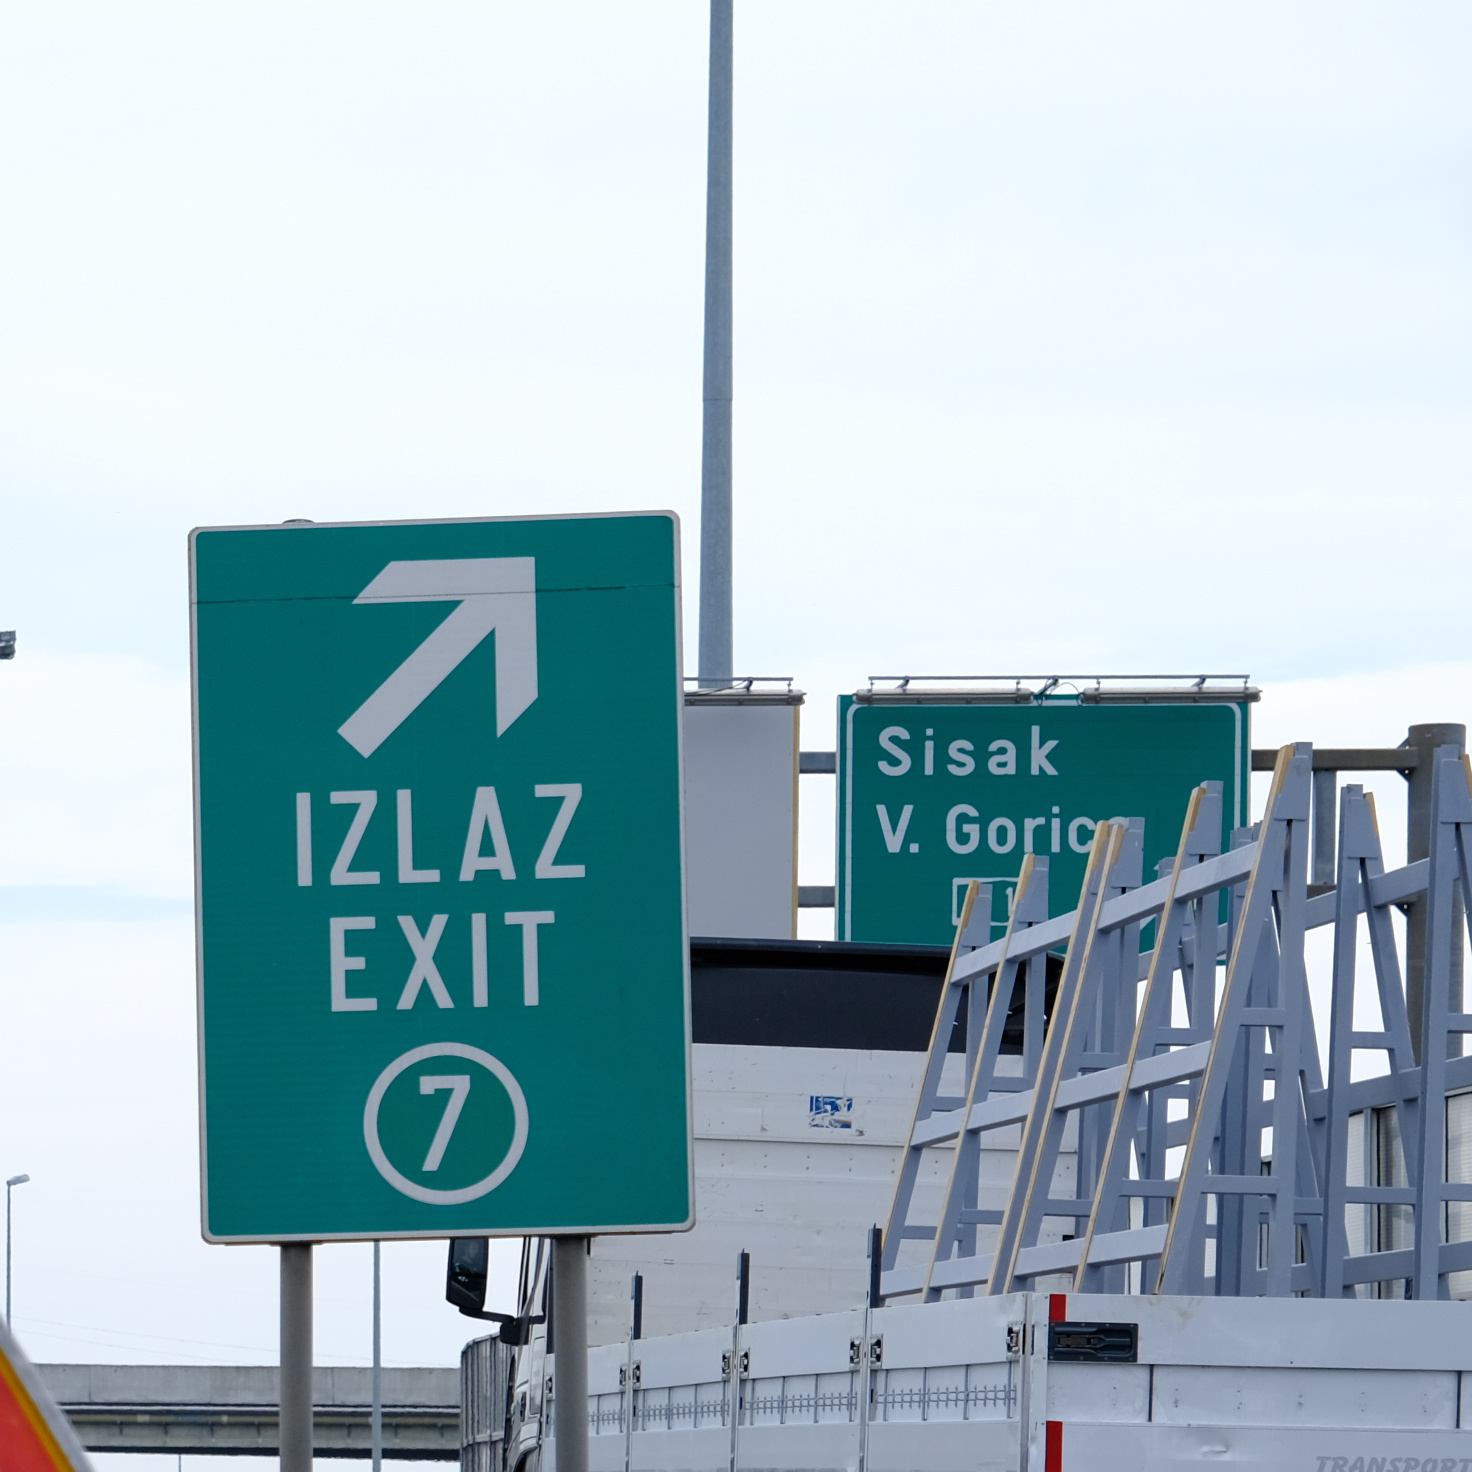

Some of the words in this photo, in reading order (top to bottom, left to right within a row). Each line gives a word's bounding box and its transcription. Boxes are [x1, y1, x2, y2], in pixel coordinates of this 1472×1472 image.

[876, 725, 1061, 778] Sisak
[294, 783, 586, 888] IZLAZ
[875, 804, 920, 854] V.
[945, 805, 1129, 856] Goric
[328, 909, 557, 1012] EXIT
[418, 1074, 471, 1173] 7
